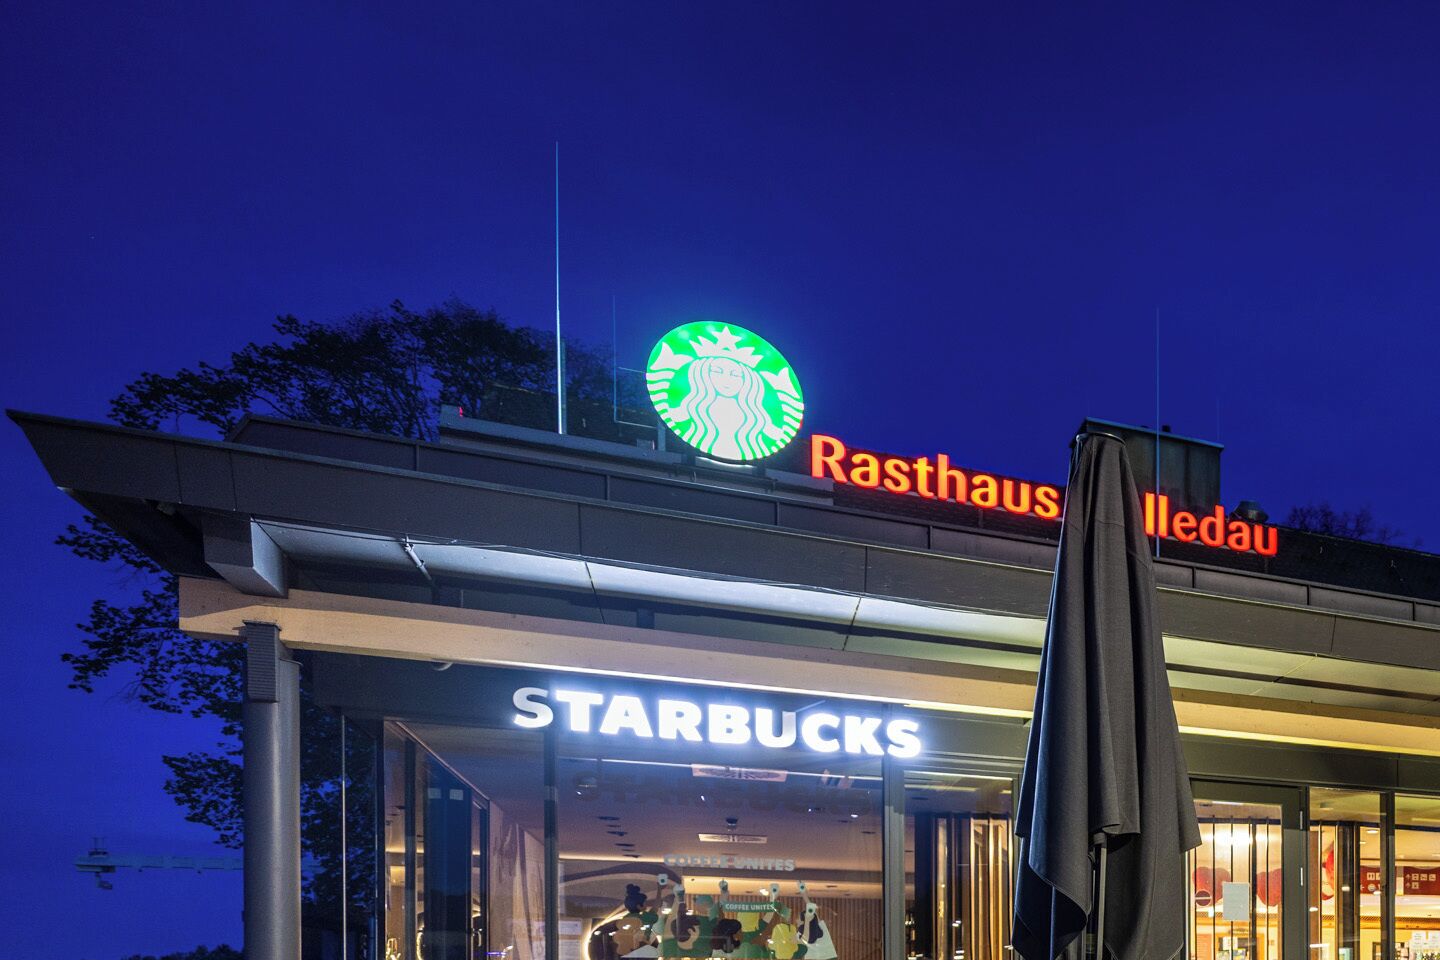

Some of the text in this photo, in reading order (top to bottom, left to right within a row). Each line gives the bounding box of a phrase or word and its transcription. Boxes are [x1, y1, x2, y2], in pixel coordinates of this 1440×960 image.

[810, 433, 1279, 557] Rasthaus lledau
[511, 685, 922, 759] STARBUCKS
[664, 854, 796, 871] COFFEE UNITES
[725, 903, 774, 911] COFFEE UNITES
